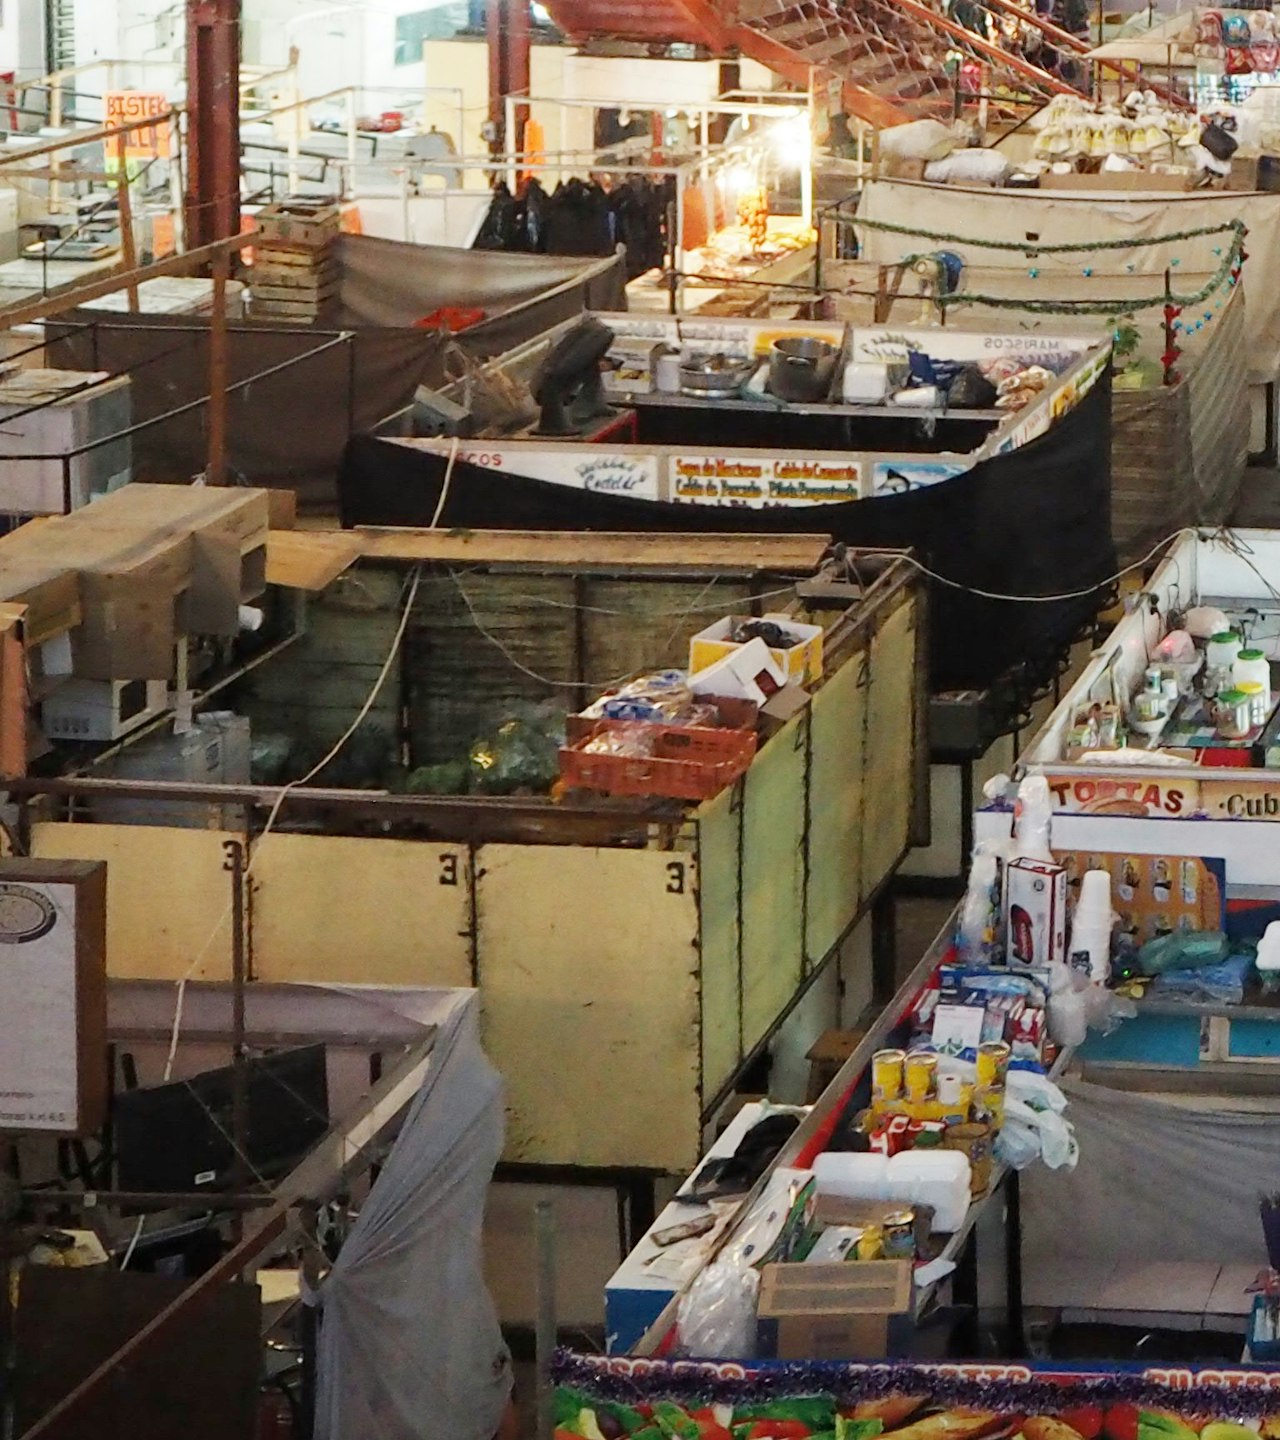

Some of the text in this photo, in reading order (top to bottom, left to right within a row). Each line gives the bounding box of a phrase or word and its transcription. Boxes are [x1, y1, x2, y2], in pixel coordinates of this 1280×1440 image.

[1050, 779, 1185, 814] TORTAS
[223, 841, 242, 871] 3
[439, 853, 458, 886] 3
[667, 861, 685, 894] 3
